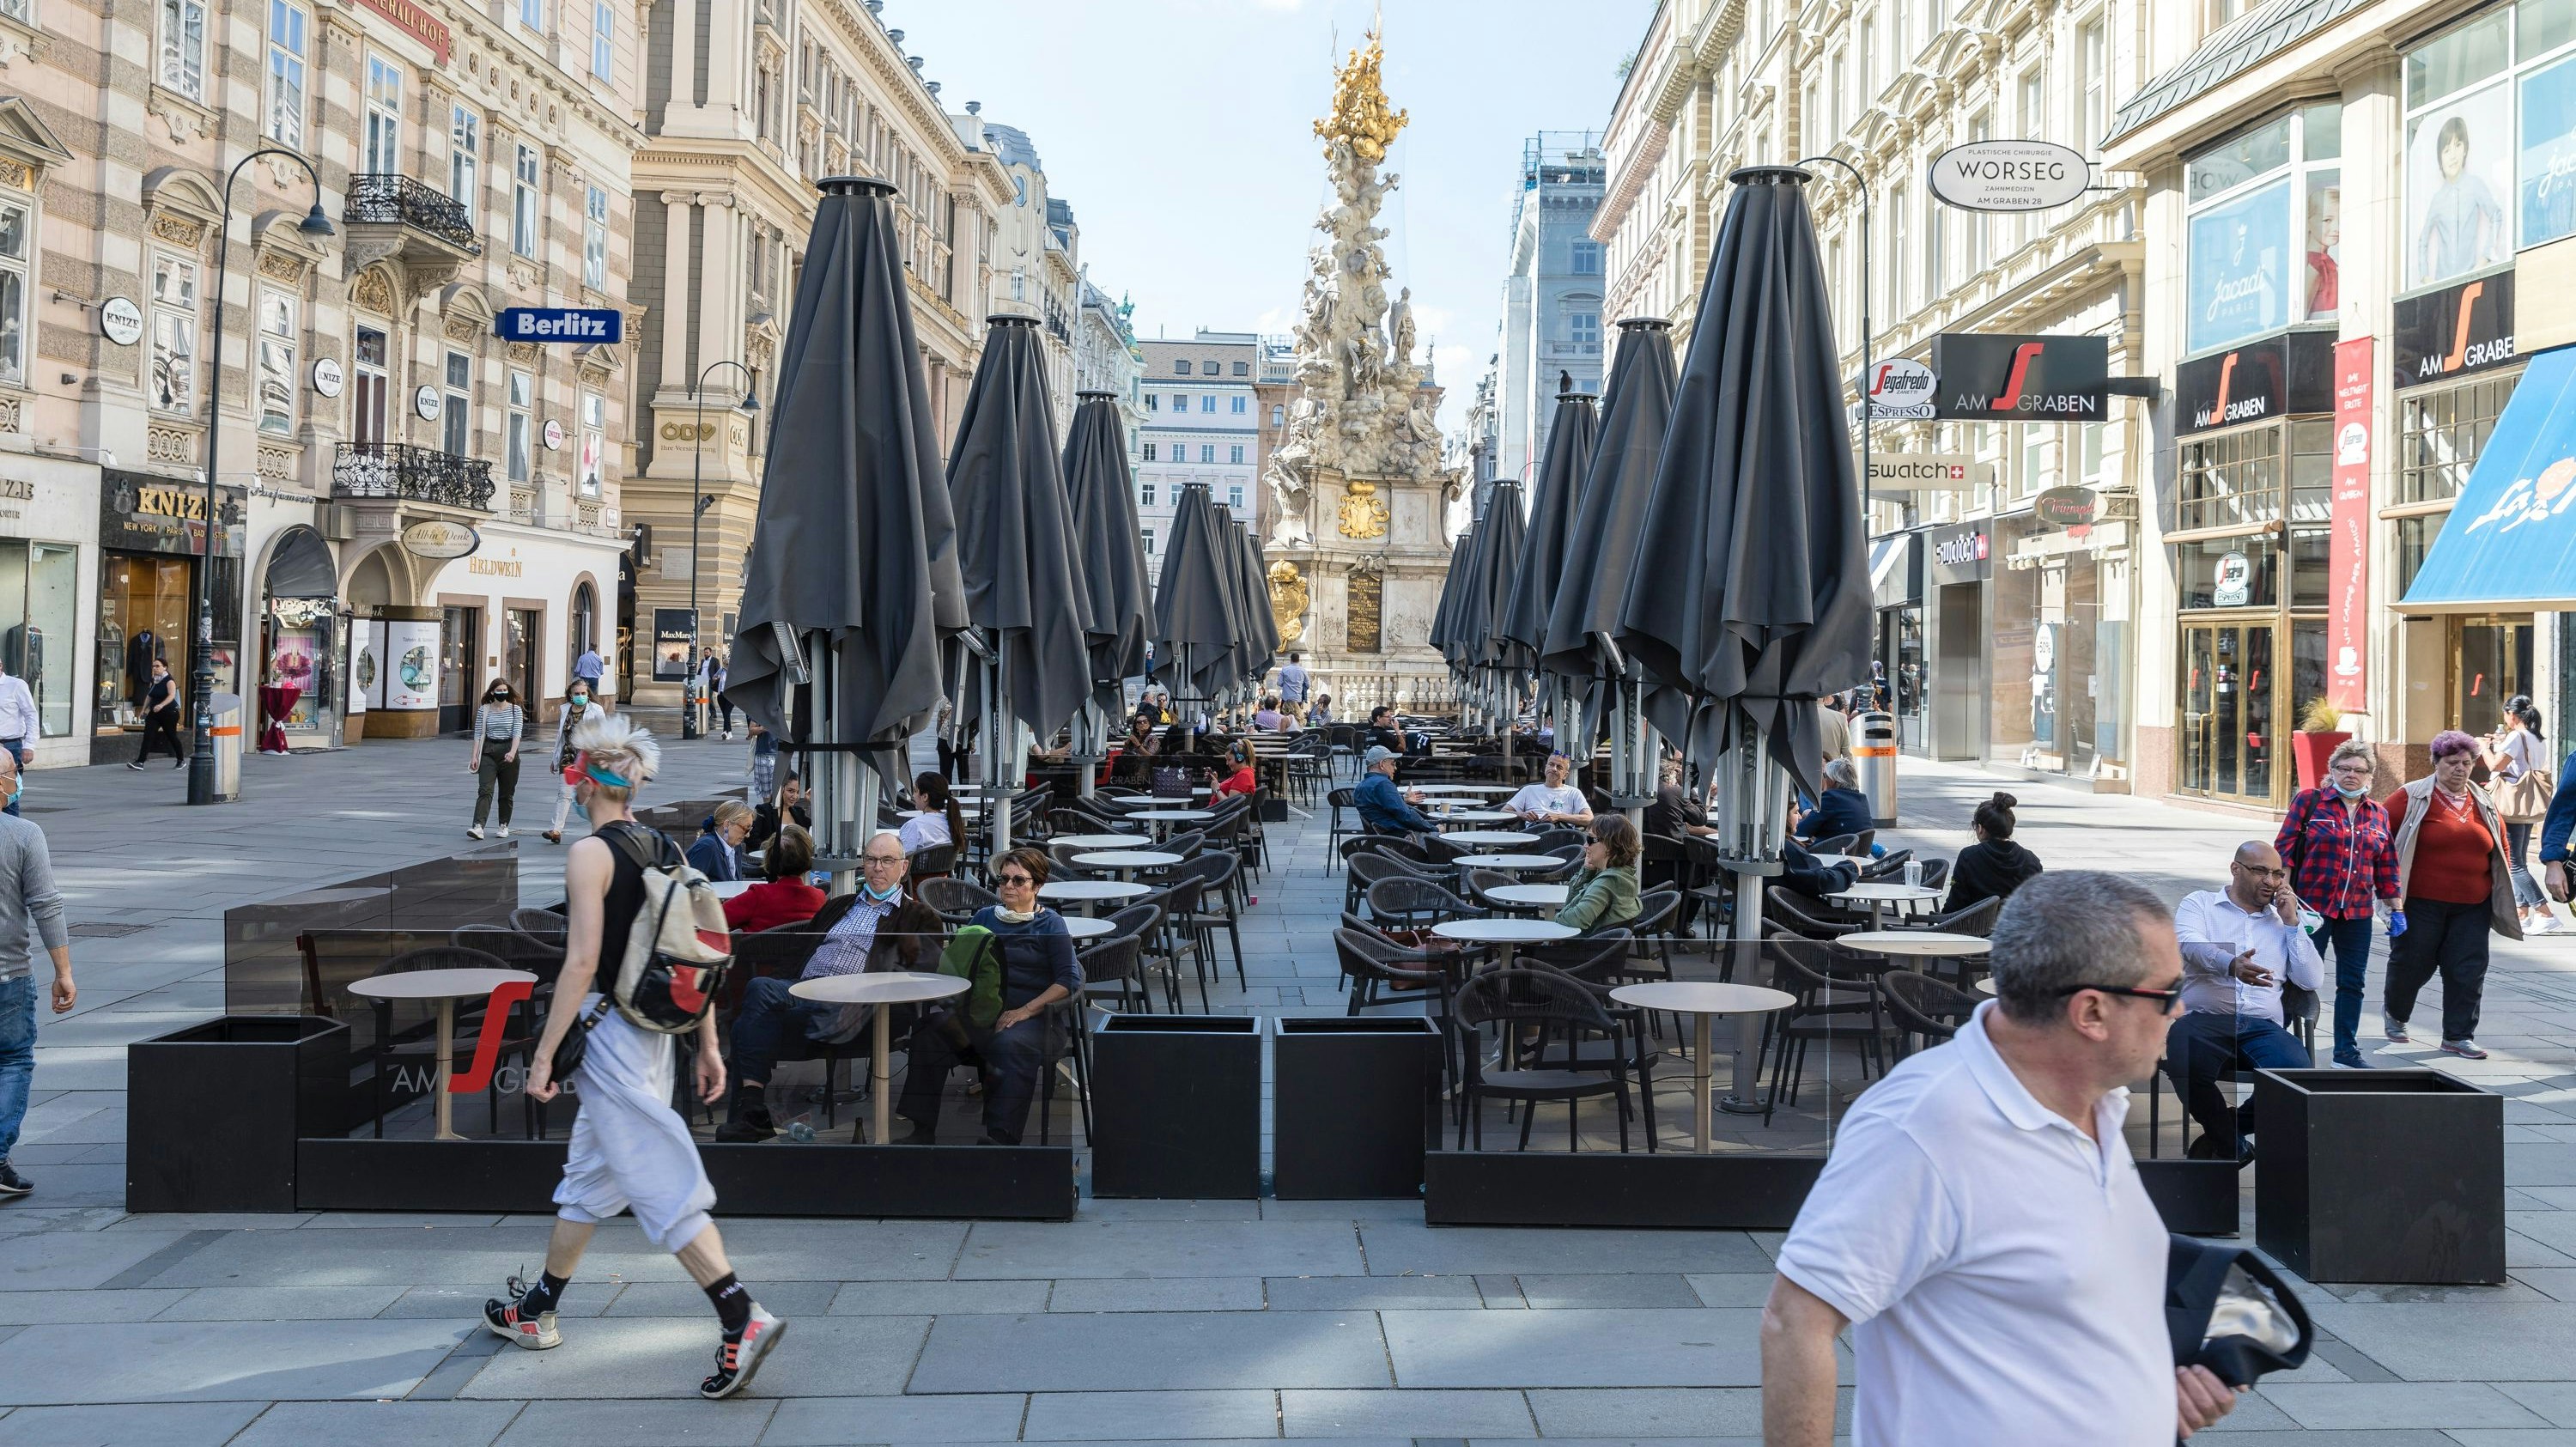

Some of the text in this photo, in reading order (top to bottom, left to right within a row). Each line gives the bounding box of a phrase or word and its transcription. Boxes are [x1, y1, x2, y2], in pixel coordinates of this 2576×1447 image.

[1956, 161, 2064, 180] WORSEG
[2207, 264, 2265, 322] jacadi
[2221, 299, 2255, 318] PARIS
[106, 312, 140, 329] KNIZE
[517, 313, 606, 336] Berlitz
[2419, 353, 2444, 378] AM
[2464, 335, 2516, 367] GRABE
[318, 370, 341, 383] KNIZE
[1870, 365, 1929, 396] Segafredo
[419, 397, 439, 408] KNIZE
[1869, 405, 1930, 417] ESPRESSO
[1954, 393, 1988, 410] AM
[2016, 394, 2095, 412] GRABEN
[2194, 409, 2211, 429] AM
[2223, 396, 2265, 422] GRABEN
[546, 429, 562, 440] KNIZE
[1869, 462, 1948, 479] swatch
[2041, 496, 2096, 520] Triumph
[124, 521, 137, 531] NEW
[140, 523, 158, 533] YORK
[167, 526, 184, 536] PARIS
[193, 529, 205, 538] BAD
[1935, 532, 1978, 566] swatch
[469, 556, 522, 578] HELDWEIN
[1110, 775, 1151, 785] GRABEN
